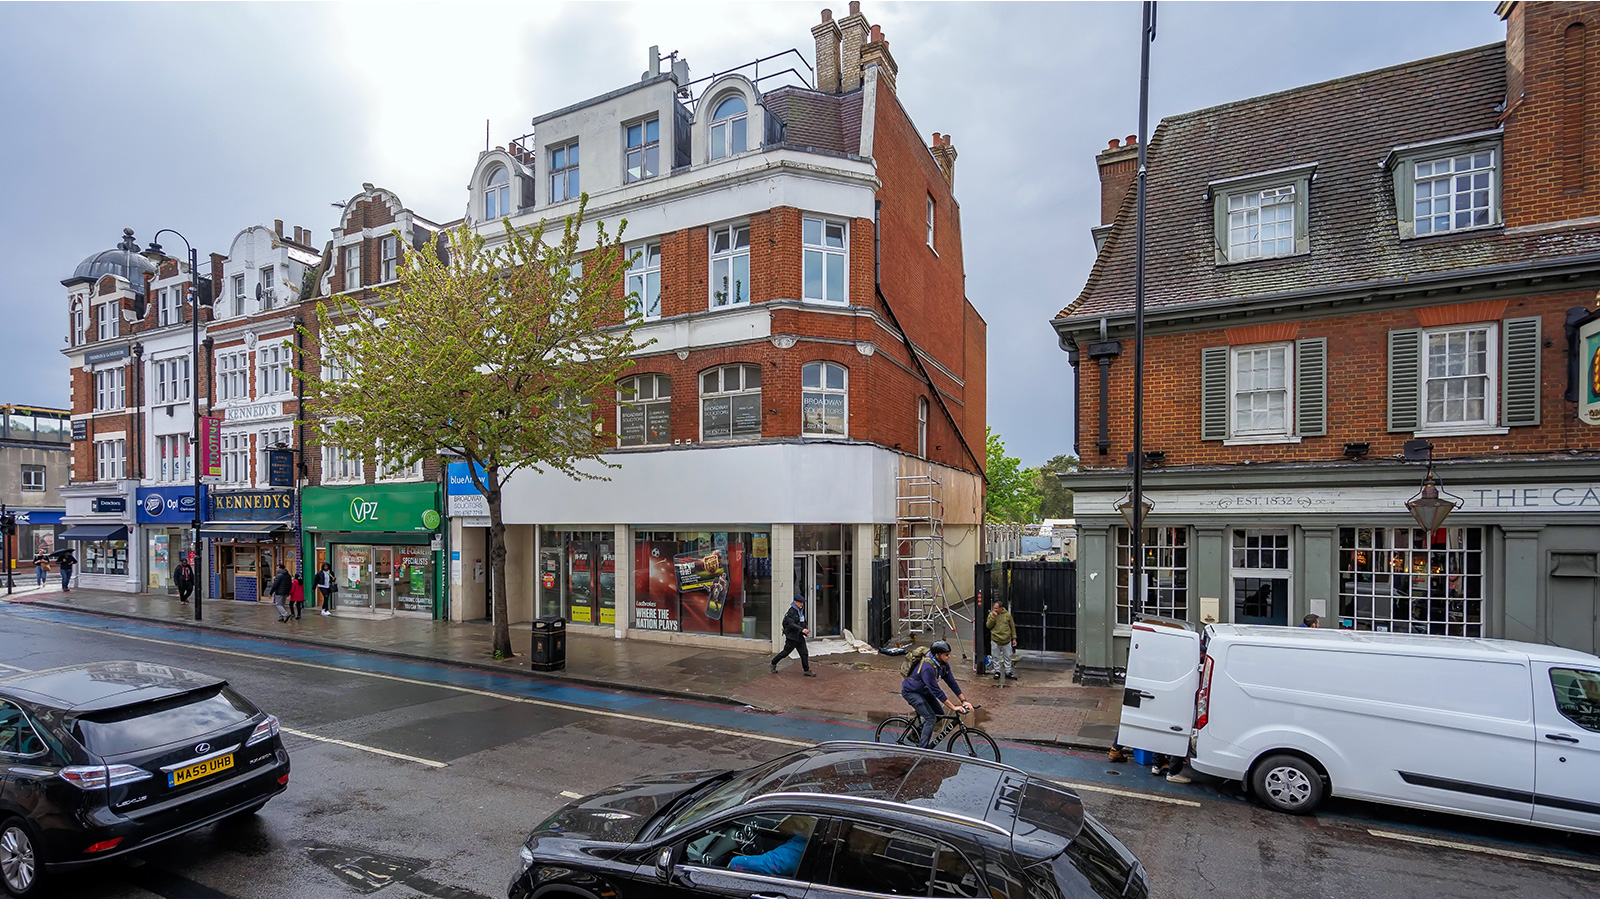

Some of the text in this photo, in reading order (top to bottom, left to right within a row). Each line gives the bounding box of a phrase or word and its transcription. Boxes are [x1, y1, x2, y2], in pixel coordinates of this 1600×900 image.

[804, 397, 843, 406] BROADWAY
[209, 419, 219, 466] TOOTING
[450, 475, 486, 485] blueArw
[216, 494, 291, 509] KENNEDYS
[1266, 496, 1293, 505] 1832
[1473, 487, 1600, 507] THE CA
[353, 501, 378, 520] VPZ
[402, 557, 428, 565] SPECIALISTS
[636, 608, 669, 619] WHERE THE
[636, 618, 678, 630] NATION PLAYS
[933, 722, 954, 745] GOKU
[176, 756, 231, 782] MA59 UHB
